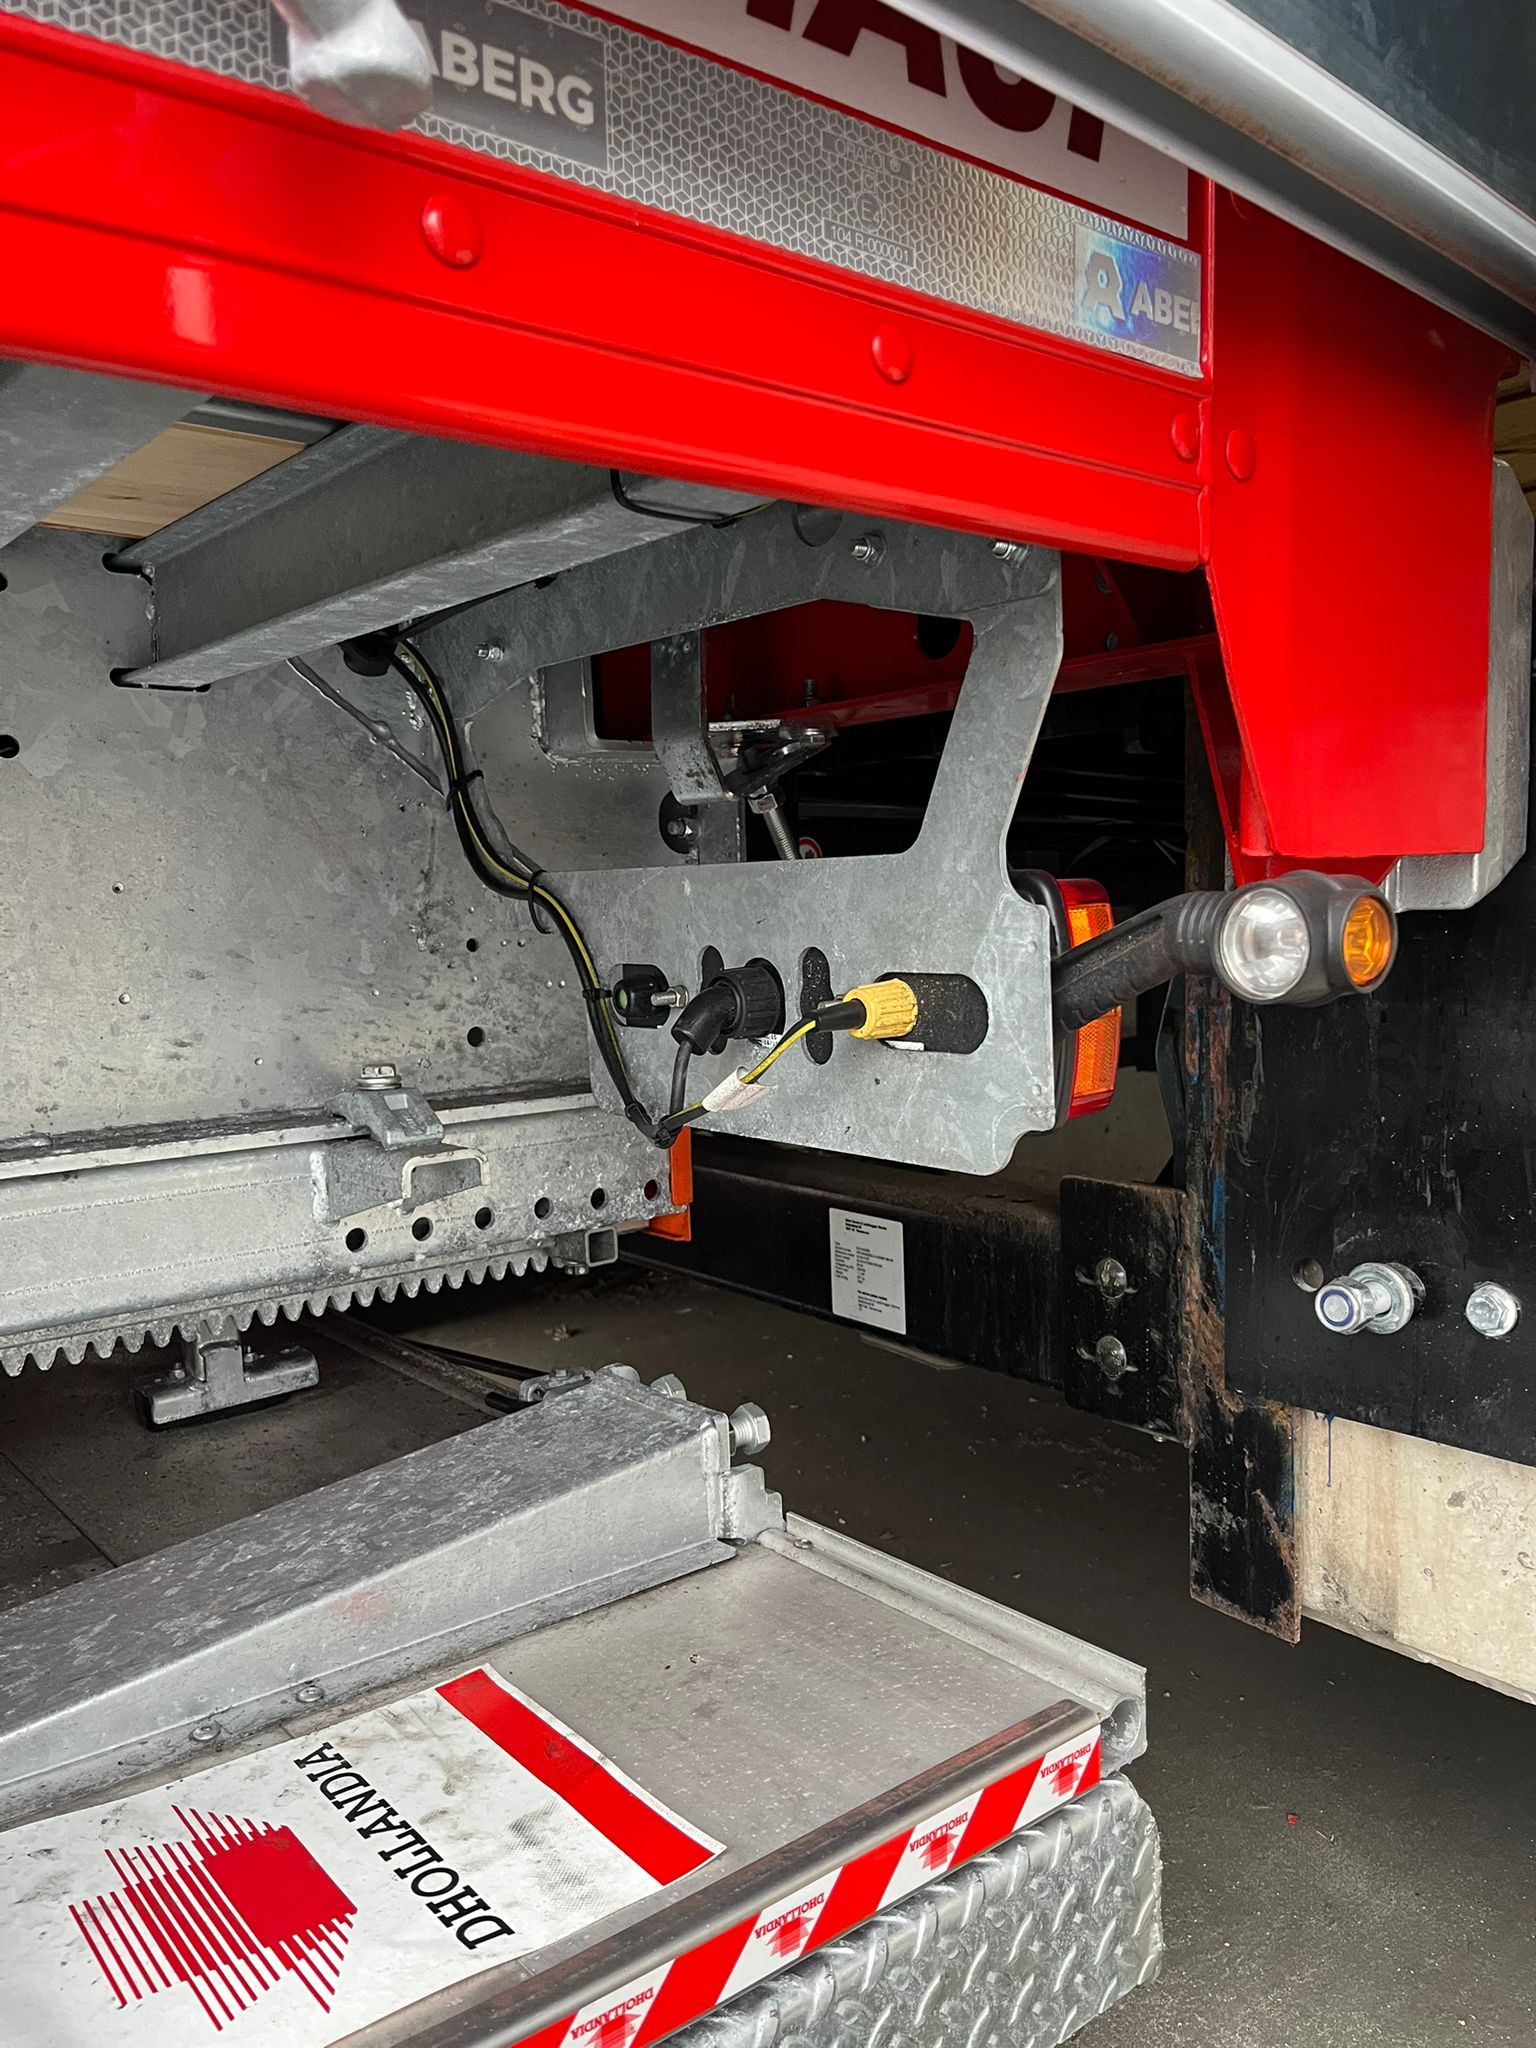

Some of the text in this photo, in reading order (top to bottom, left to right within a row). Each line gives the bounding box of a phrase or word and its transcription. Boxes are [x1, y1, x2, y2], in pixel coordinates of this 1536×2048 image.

[1041, 1742, 1091, 1779] DHOLLANDIA
[294, 1742, 515, 1950] DHOLLANDIA
[909, 1811, 969, 1853] DHOLLANDIA
[754, 1891, 825, 1940] DHOLLANDIA
[570, 1986, 654, 2041] DHOLLANDIA
